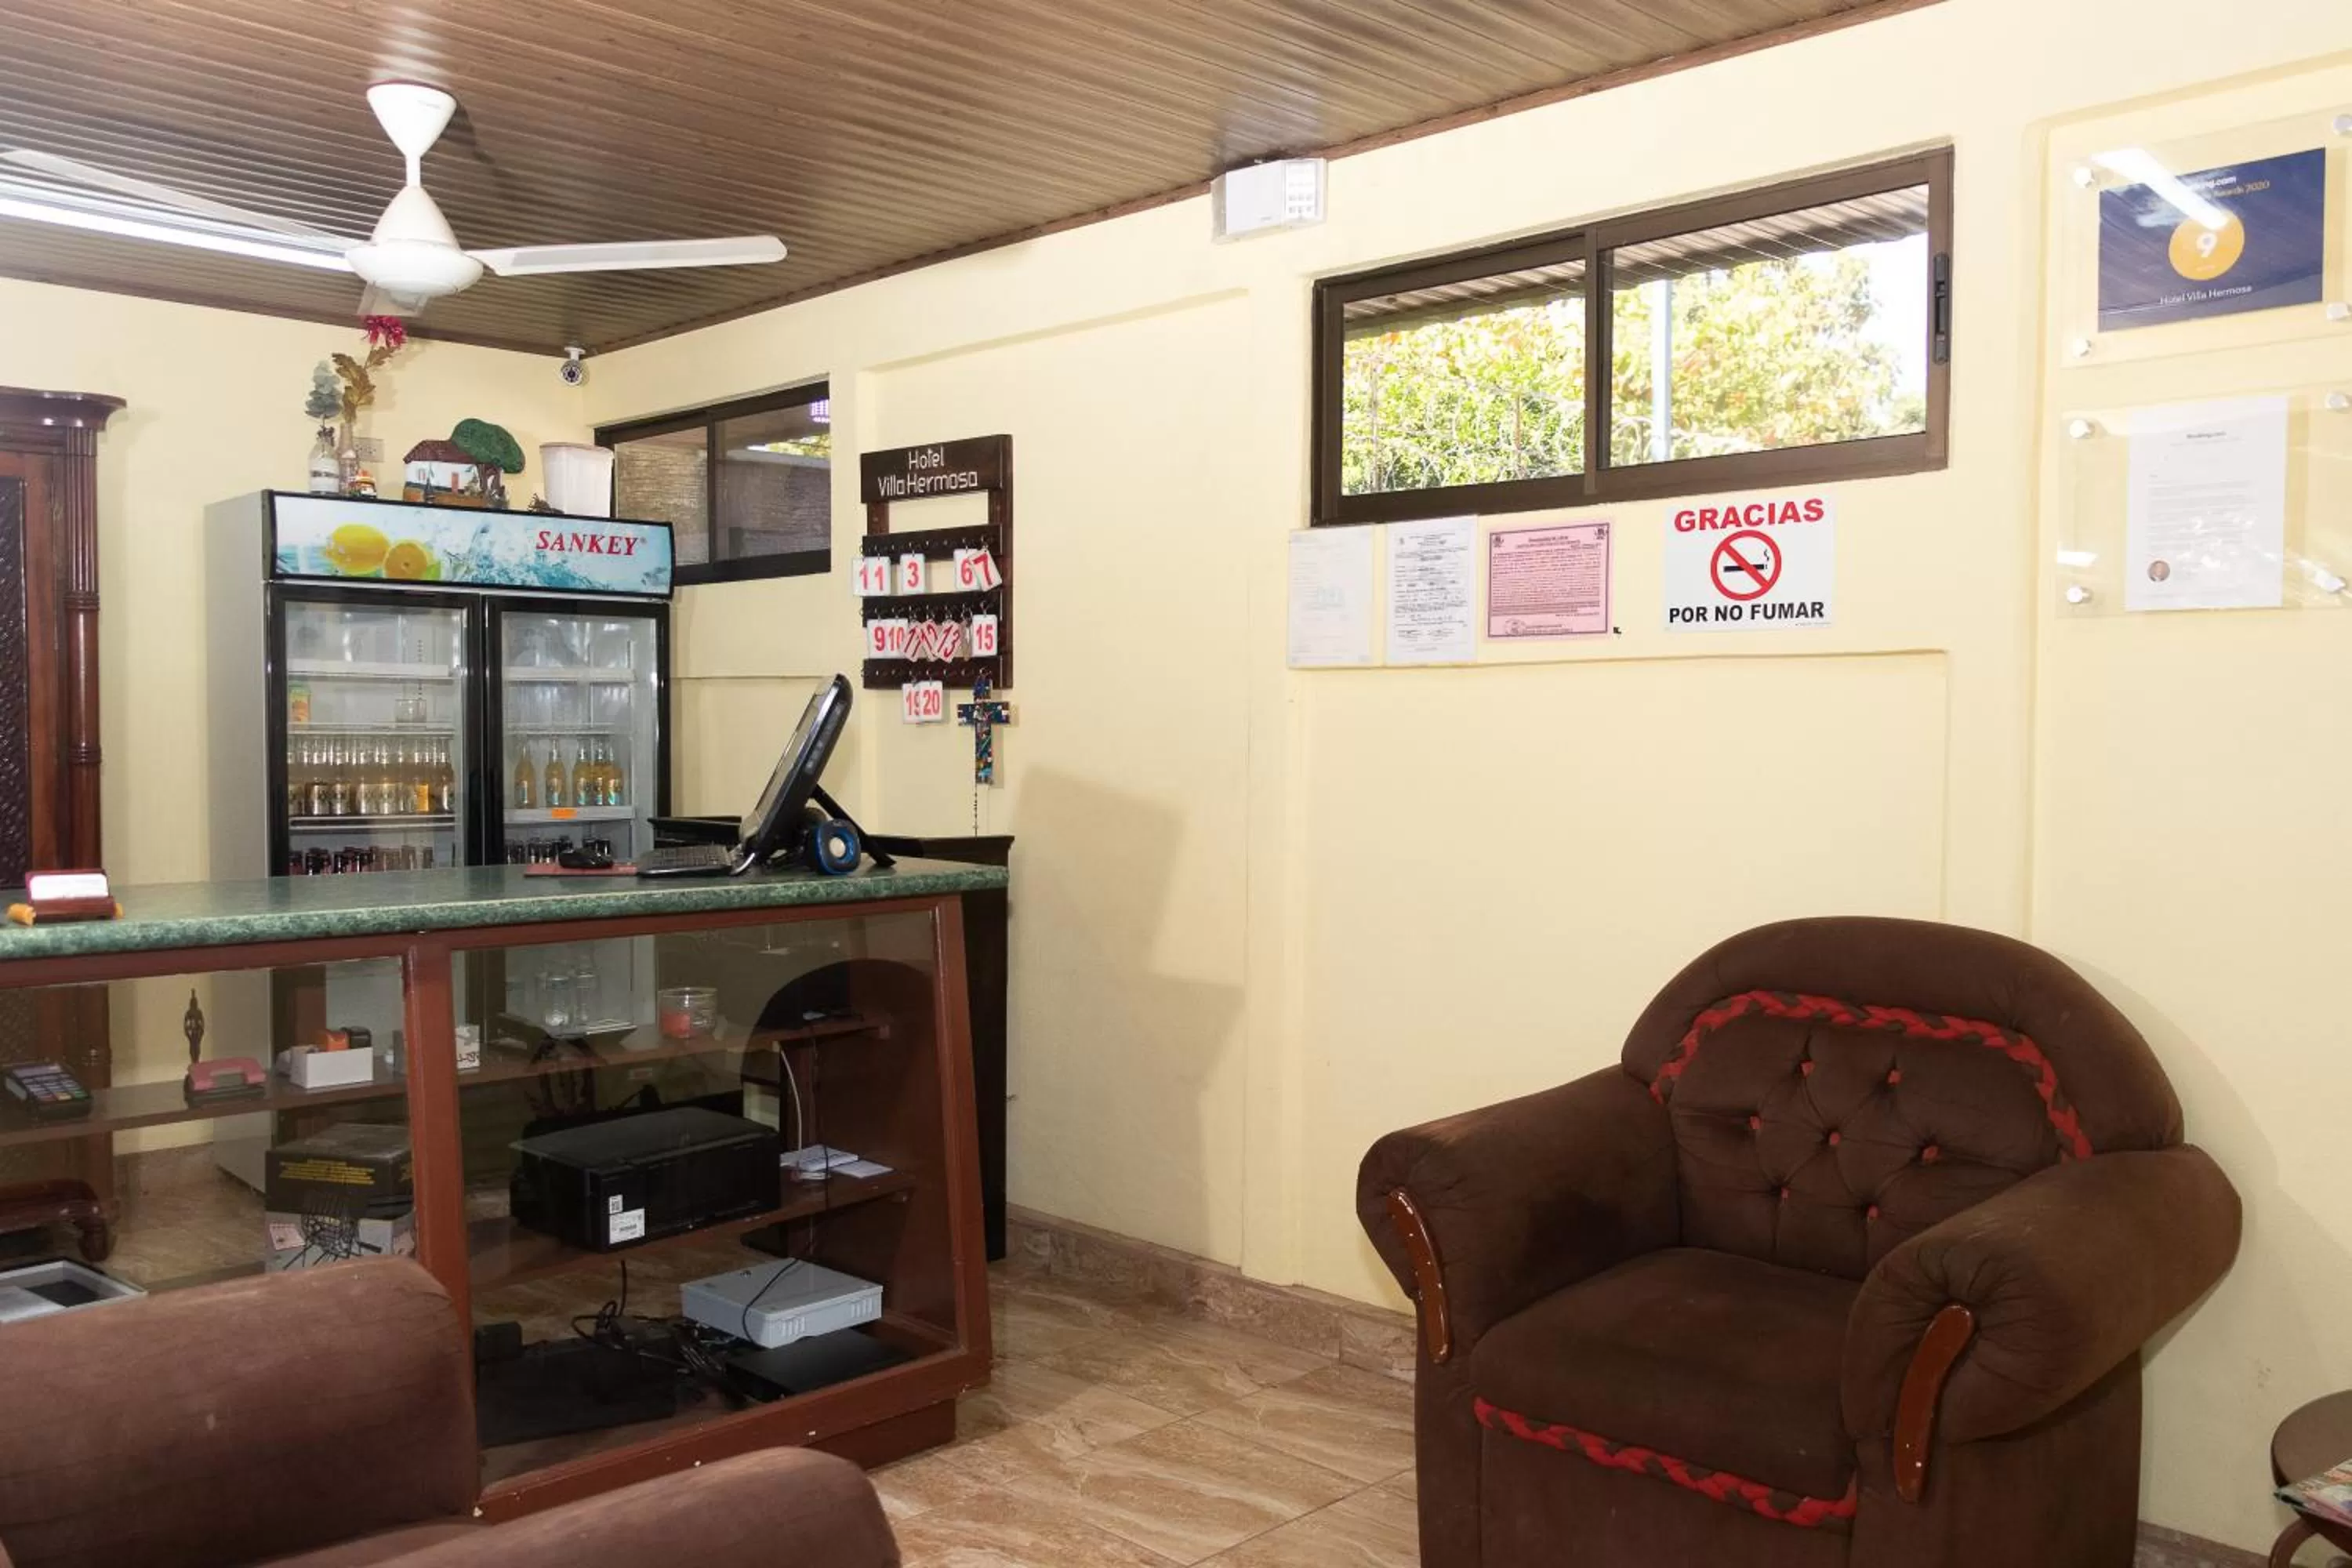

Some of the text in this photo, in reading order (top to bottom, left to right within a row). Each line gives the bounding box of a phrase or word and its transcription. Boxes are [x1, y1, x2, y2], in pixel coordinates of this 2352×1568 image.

[2197, 232, 2218, 258] 9
[2209, 285, 2252, 298] Hermosa
[908, 445, 944, 470] Hotel
[877, 470, 978, 497] Villa Hermosa
[1674, 498, 1824, 532] GRACIAS
[535, 531, 639, 556] SANKEY
[858, 564, 868, 590] 1
[874, 565, 884, 591] 1
[907, 561, 920, 588] 3
[960, 557, 973, 586] 6
[972, 552, 993, 586] 7
[1668, 601, 1824, 623] POR NO FUMAR
[873, 626, 886, 652] 9
[938, 625, 960, 658] 13
[975, 624, 994, 651] 15
[922, 690, 940, 716] 20
